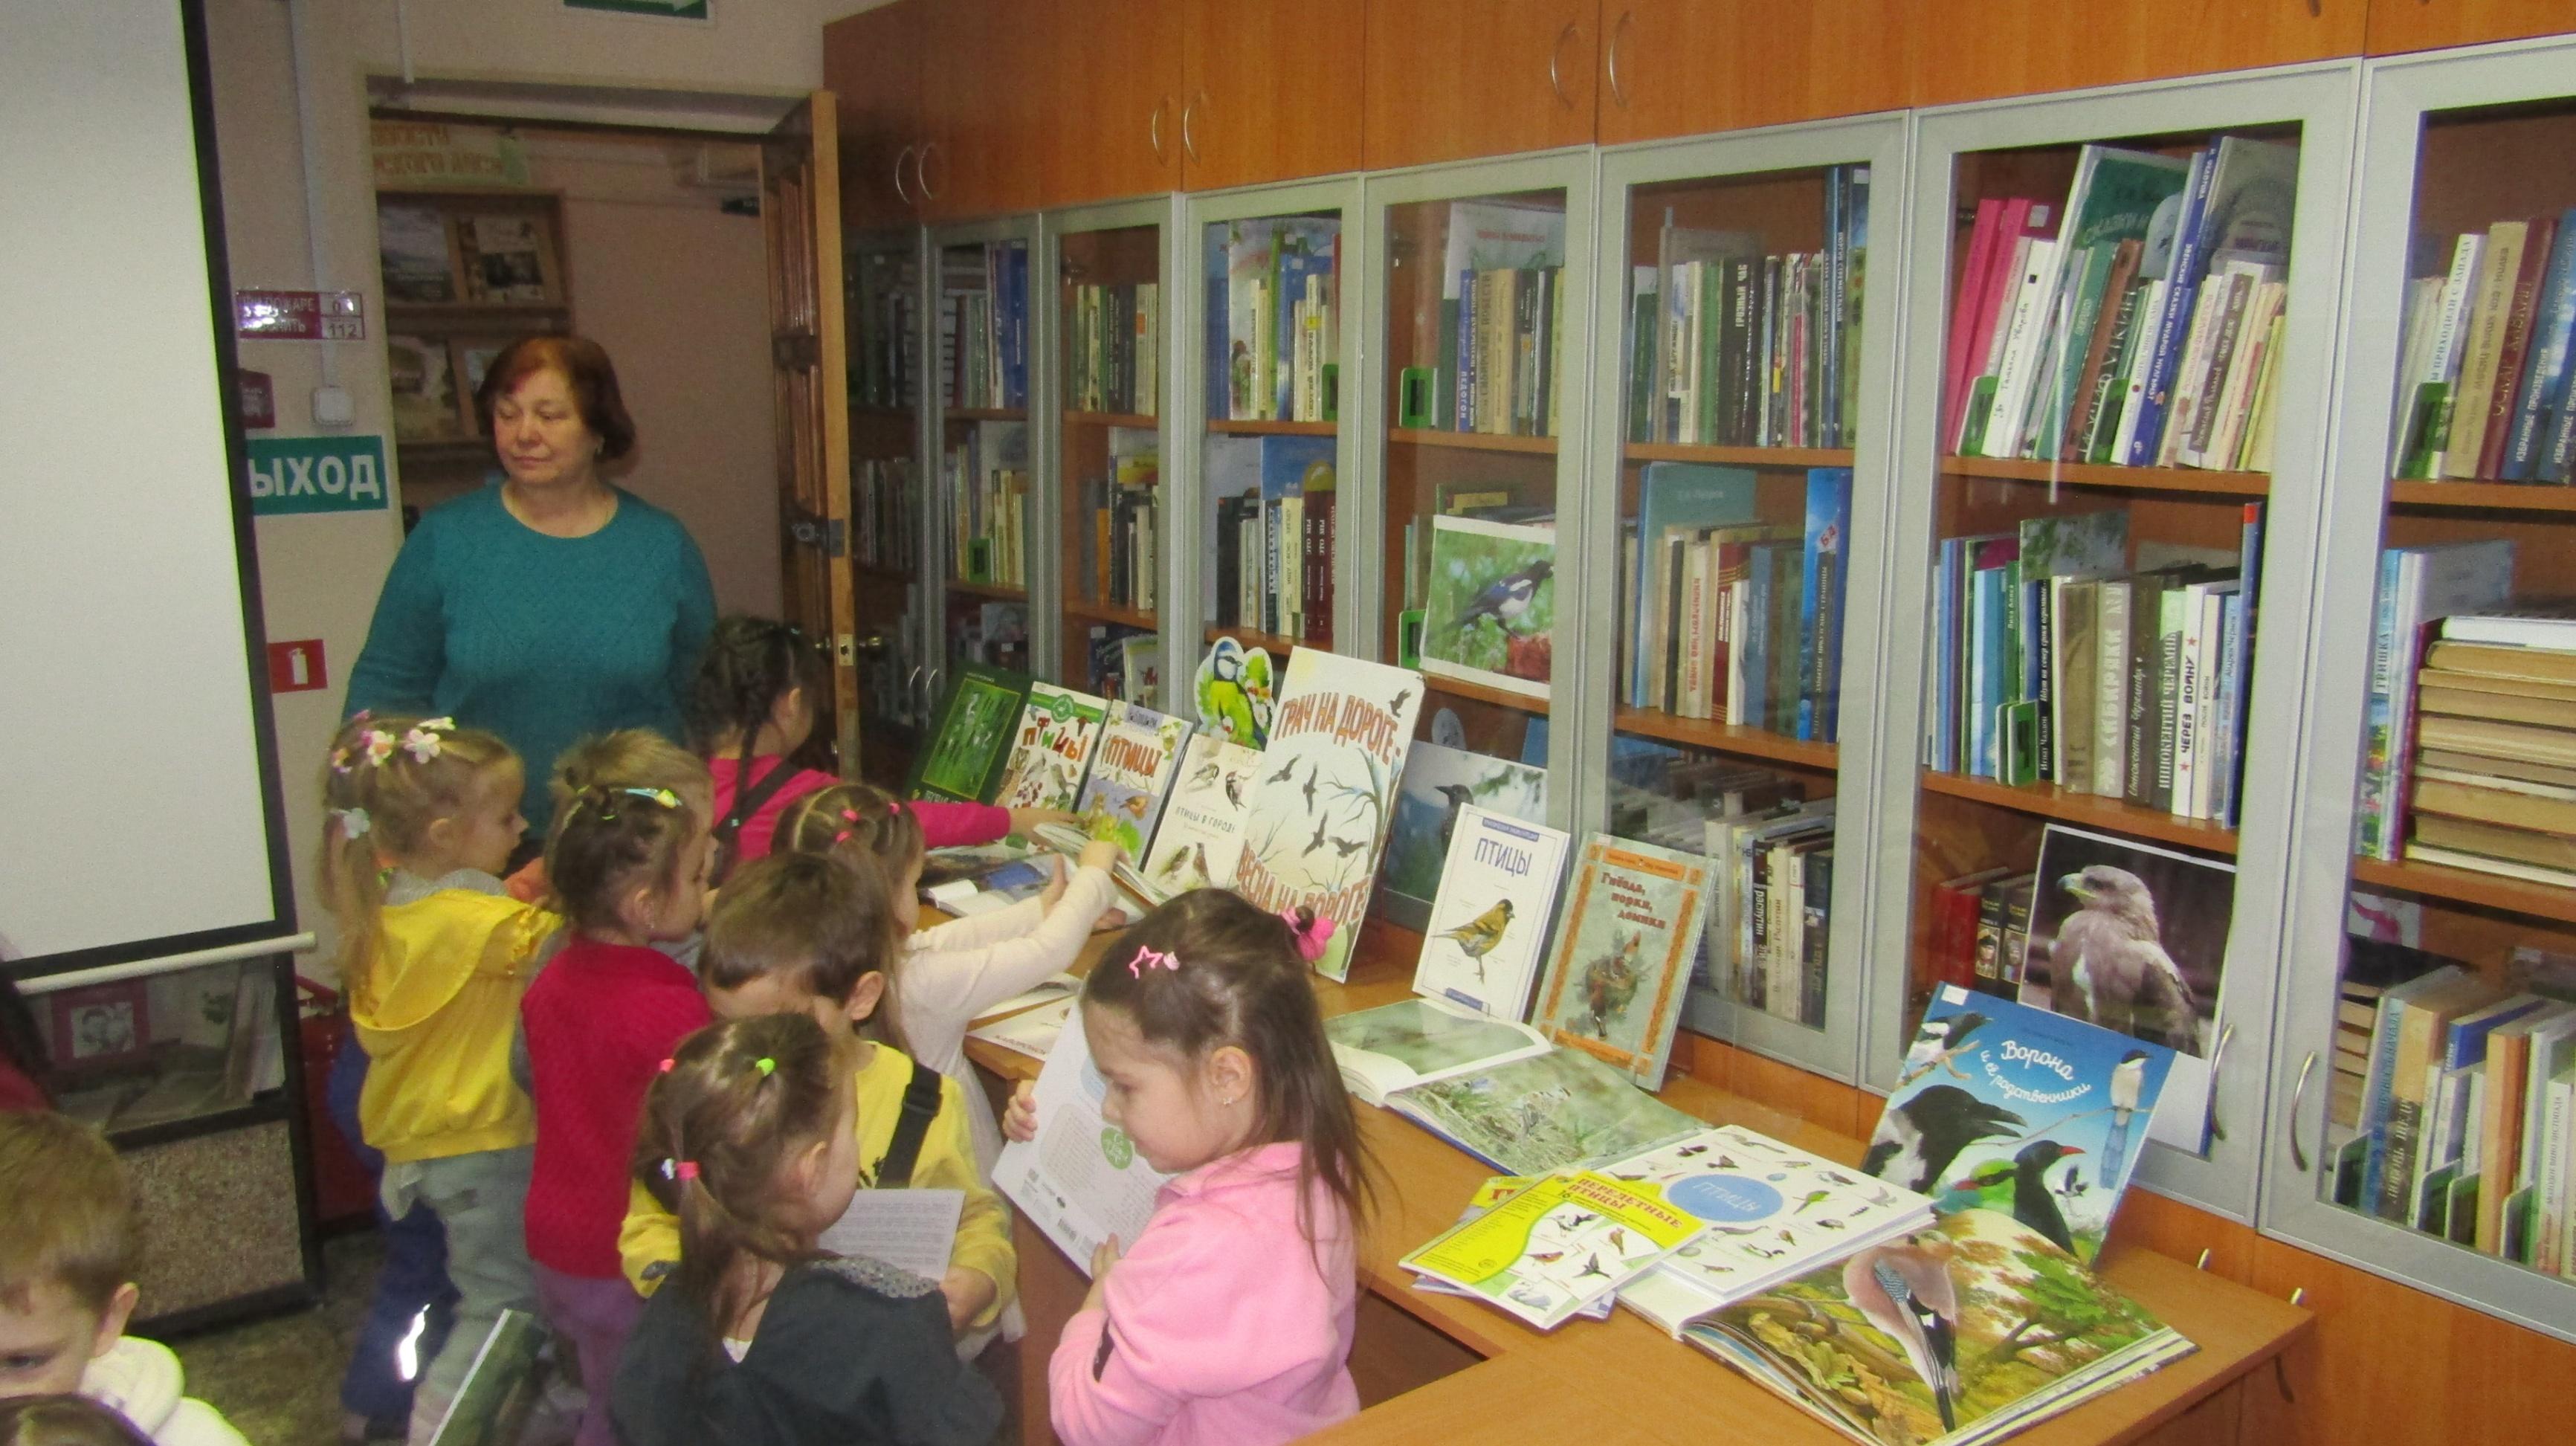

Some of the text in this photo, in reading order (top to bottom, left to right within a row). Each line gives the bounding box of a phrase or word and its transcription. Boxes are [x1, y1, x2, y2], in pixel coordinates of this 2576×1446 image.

[2176, 243, 2193, 284] ЭВЕНСКИЕ
[1735, 265, 1748, 327] ГРОЗНЫЙ ЧАС
[1836, 262, 1844, 322] СТРЕМИТЕЛЬНЫЙ
[2169, 286, 2182, 320] СКАЗКИ
[2432, 299, 2458, 369] ПРИХОДИЛИ
[2450, 239, 2472, 285] ЗАПАДА
[329, 323, 358, 338] 112
[2158, 320, 2174, 356] МУДРОЙ
[2515, 348, 2549, 462] ИЗБРАННЫЕ ПРОИЗВЕДЕНИЯ
[2553, 416, 2575, 464] ИЗБРАННЫЕ
[248, 454, 381, 501] ЫХОД
[2375, 631, 2389, 691] ГРИШКА
[2040, 680, 2049, 702] Идут
[2099, 629, 2122, 747] СИБИРЯКИ
[2157, 630, 2178, 789] ИННОКЕНТИЙ ЧЕРЕМНЫ
[2180, 654, 2195, 753] ЧЕРЕЗ ВОЙНУ
[1274, 693, 1317, 741] ГРАЧ
[1311, 691, 1339, 734] НА
[1334, 694, 1398, 765] ДОРОГЕ
[1104, 735, 1163, 778] ПТИЦЫ
[2128, 724, 2142, 796] Иннокентий
[1175, 807, 1200, 821] ПТИЦЫ
[1201, 815, 1207, 824] В
[1208, 817, 1236, 833] ГОРОДЕ
[1474, 837, 1532, 877] ПТИЦЫ
[1601, 872, 1645, 895] Гнёзда,
[1611, 892, 1653, 913] норки,
[1981, 1050, 1990, 1062] и
[1989, 1074, 2092, 1103] родственники
[2001, 1040, 2074, 1081] Ворона
[1568, 1184, 1627, 1210] ПТИЦЫ
[1578, 1178, 1683, 1229] ПЕРЕЛЕТНЫЕ
